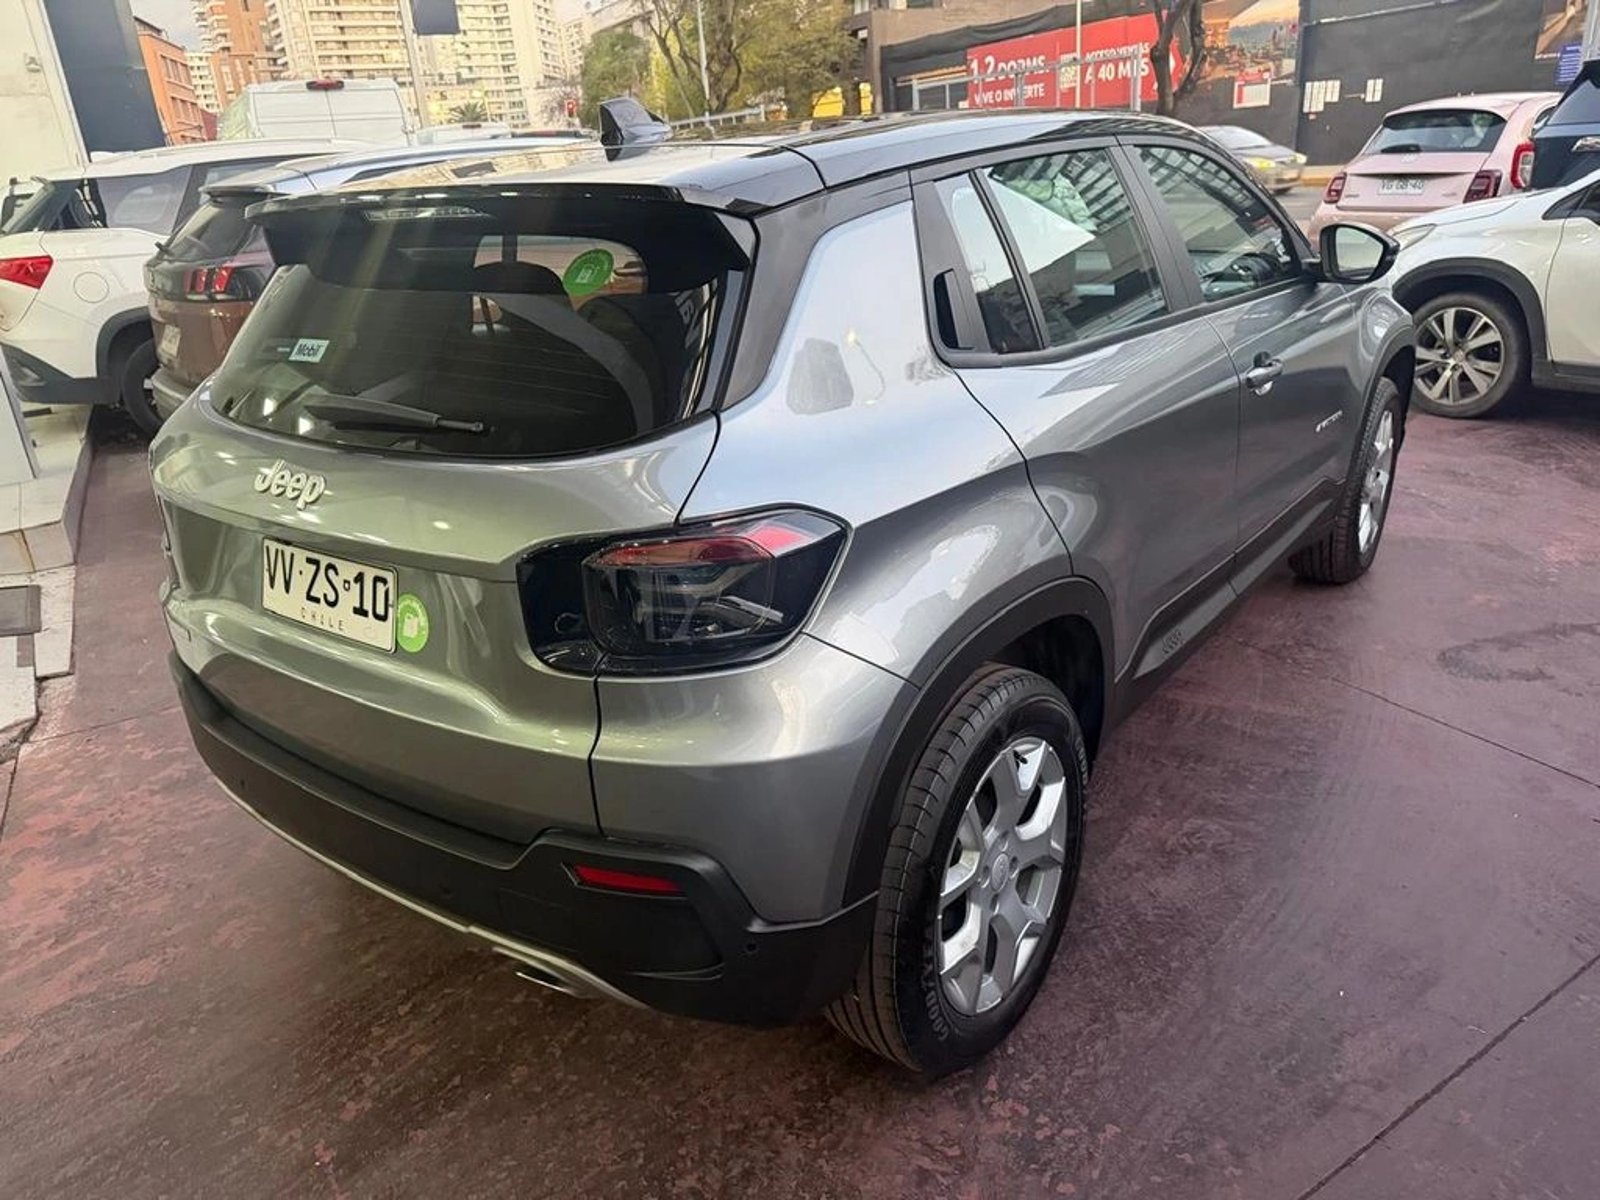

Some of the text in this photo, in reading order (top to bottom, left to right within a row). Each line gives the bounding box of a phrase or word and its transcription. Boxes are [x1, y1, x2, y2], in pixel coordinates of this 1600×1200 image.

[1097, 62, 1116, 82] 40
[254, 459, 326, 511] Jeep
[301, 606, 345, 632] CHILE
